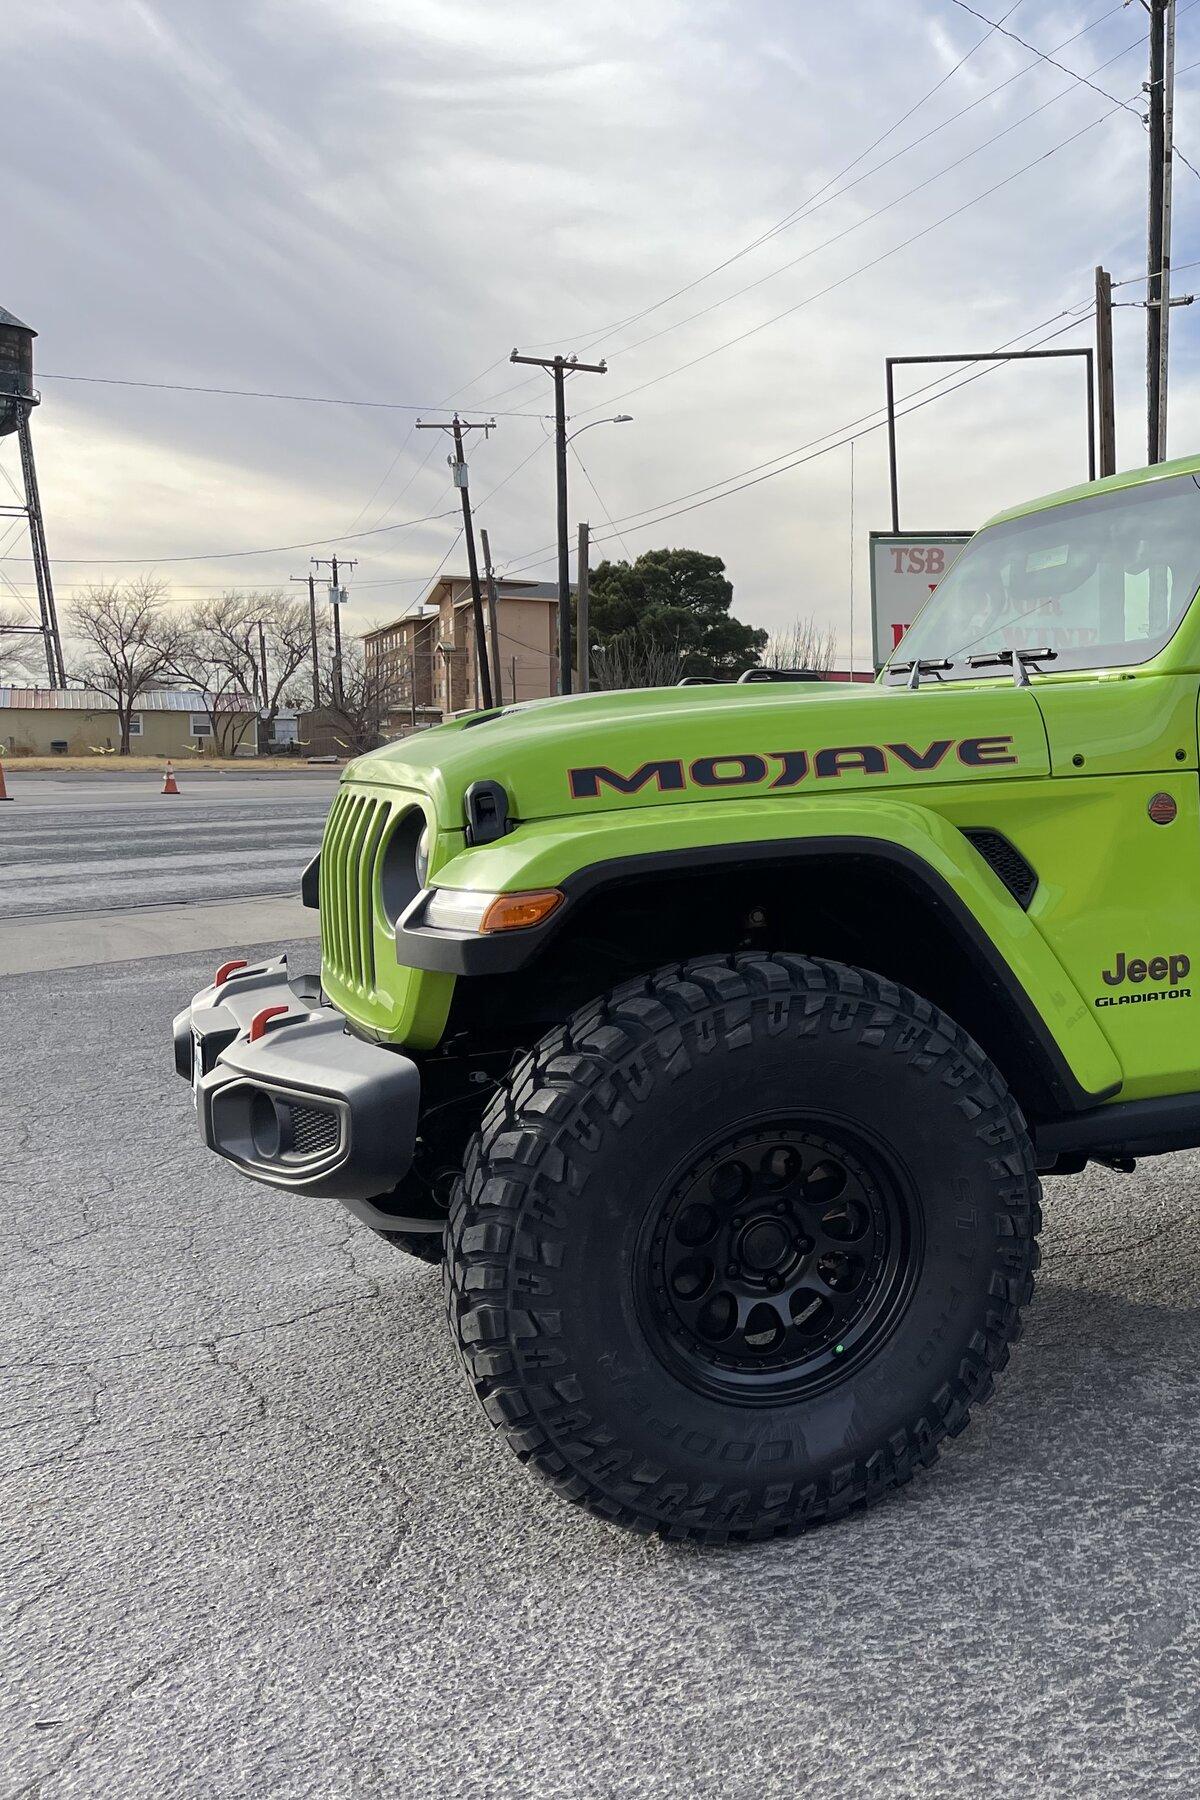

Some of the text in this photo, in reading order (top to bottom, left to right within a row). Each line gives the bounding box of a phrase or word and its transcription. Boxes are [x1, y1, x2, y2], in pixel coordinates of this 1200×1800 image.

[890, 548, 945, 574] TSB
[566, 735, 1019, 800] MOJAVE
[1102, 953, 1191, 985] Jeep
[1094, 988, 1191, 1008] GLADIATOR
